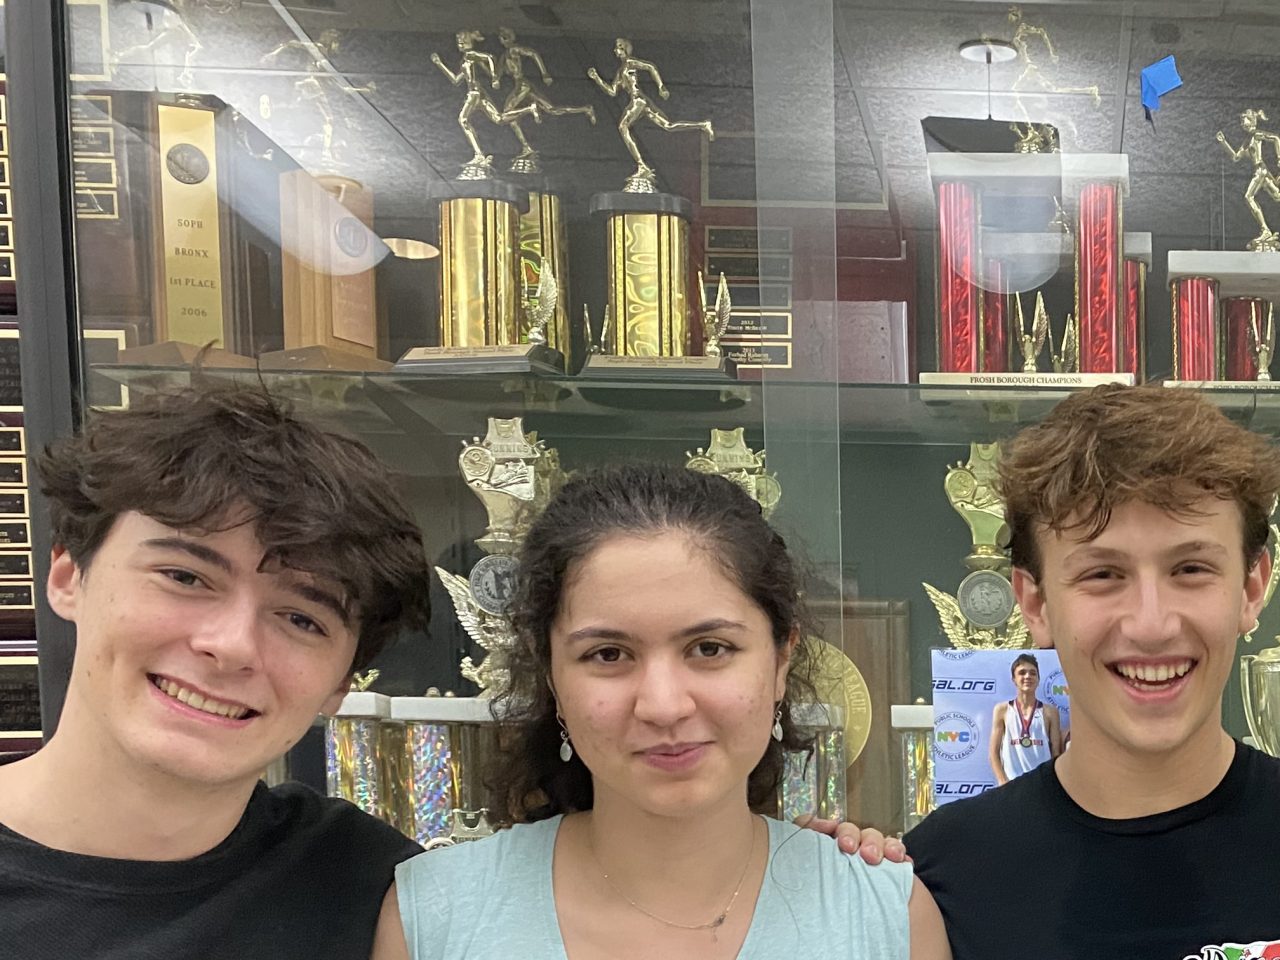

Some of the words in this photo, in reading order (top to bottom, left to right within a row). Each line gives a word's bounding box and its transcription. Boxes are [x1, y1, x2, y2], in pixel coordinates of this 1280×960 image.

[177, 218, 203, 229] SOPH
[174, 247, 209, 258] BRONX
[185, 278, 217, 289] PLACE
[181, 307, 208, 317] 2006
[970, 376, 995, 384] FROSH
[996, 376, 1035, 384] BOROUGH
[1036, 376, 1082, 384] CHAMPIONS
[1053, 685, 1071, 695] NY
[953, 713, 975, 728] SCHOOLS
[937, 731, 970, 743] NYC
[955, 745, 975, 760] LEAGUE
